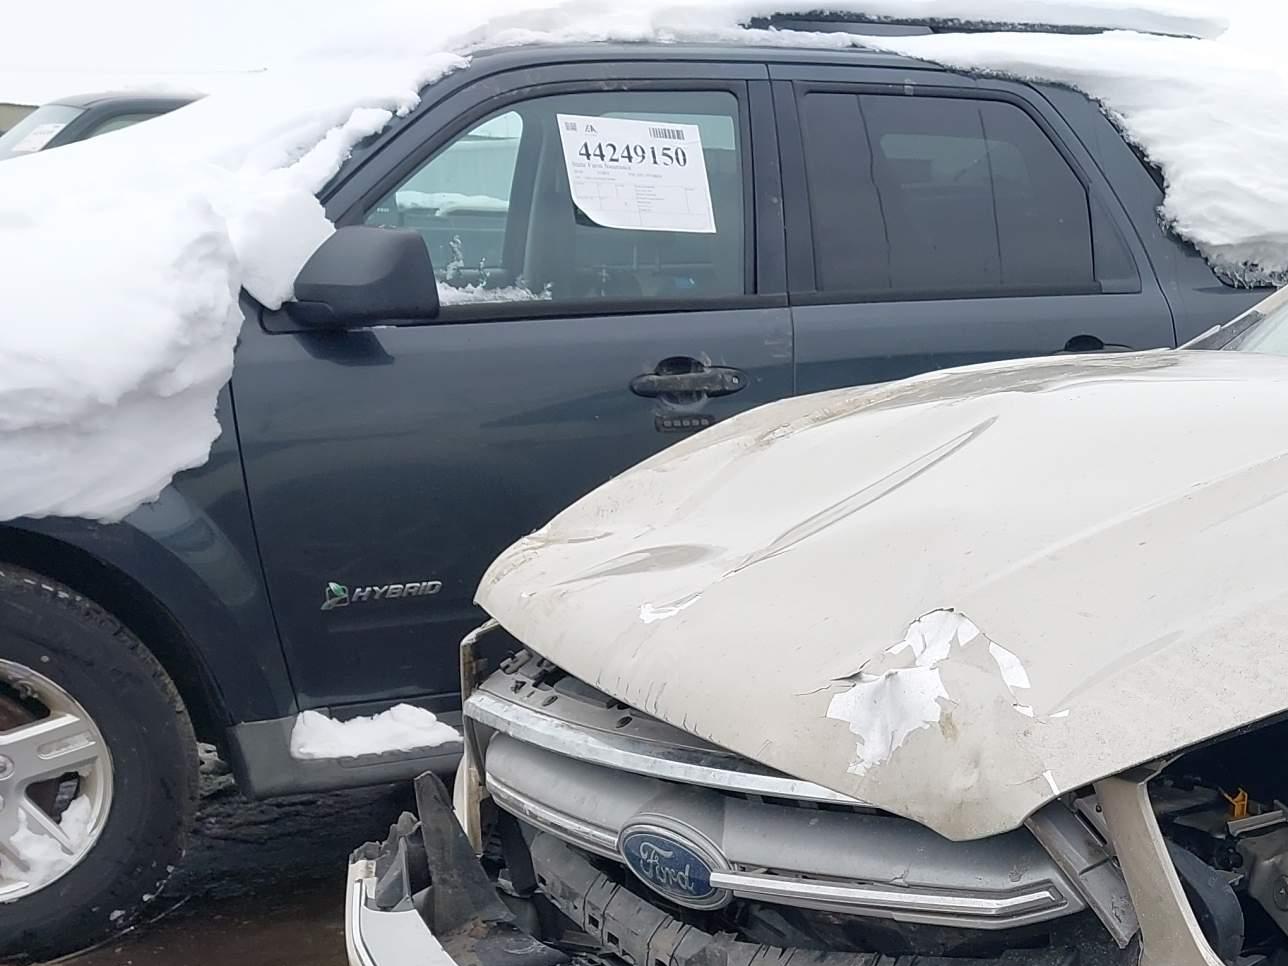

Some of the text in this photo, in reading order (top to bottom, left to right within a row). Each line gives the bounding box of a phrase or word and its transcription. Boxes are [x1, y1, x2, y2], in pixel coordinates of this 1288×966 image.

[578, 141, 687, 167] 44249150
[351, 580, 443, 602] HYBRID
[639, 841, 696, 895] Ford
